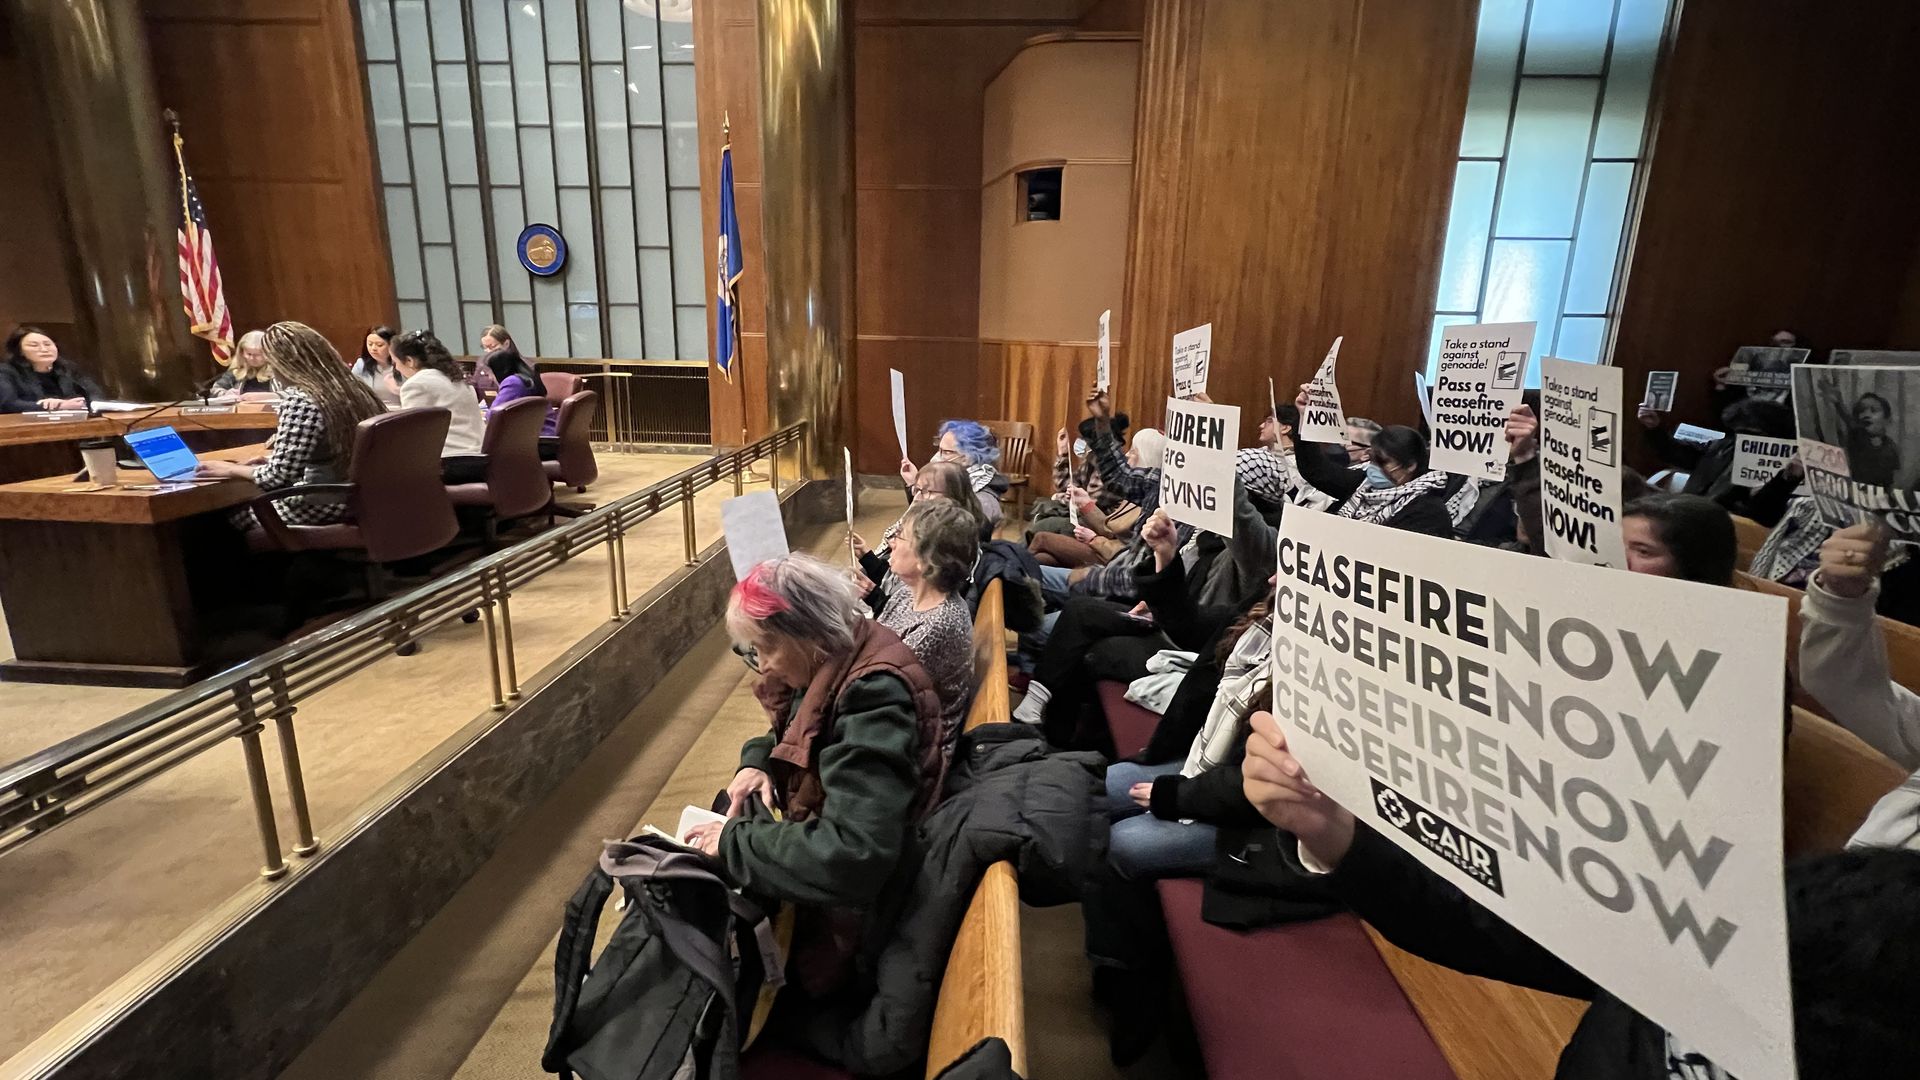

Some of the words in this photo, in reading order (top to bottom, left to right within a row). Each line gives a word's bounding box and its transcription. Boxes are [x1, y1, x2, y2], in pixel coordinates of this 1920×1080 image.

[1445, 339, 1468, 349] Take
[1479, 338, 1511, 349] stand
[1441, 359, 1489, 372] genocide!
[1443, 350, 1479, 362] against
[1438, 376, 1472, 393] Pass
[1475, 382, 1486, 392] a
[1544, 375, 1562, 393] Take
[1564, 386, 1570, 395] a
[1571, 386, 1598, 402] stand
[1436, 393, 1505, 411] ceasefire
[1544, 395, 1572, 412] against
[1435, 428, 1495, 455] NOW!
[1544, 427, 1569, 458] Pass
[1572, 446, 1581, 462] a
[1741, 439, 1798, 458] CHILDR
[1164, 447, 1186, 468] are
[1757, 458, 1782, 469] are
[1543, 457, 1603, 494] ceasefire
[1163, 473, 1216, 511] RVING
[1543, 479, 1615, 523] resolution
[1544, 499, 1598, 554] NOW!
[1416, 811, 1493, 876] CAIR
